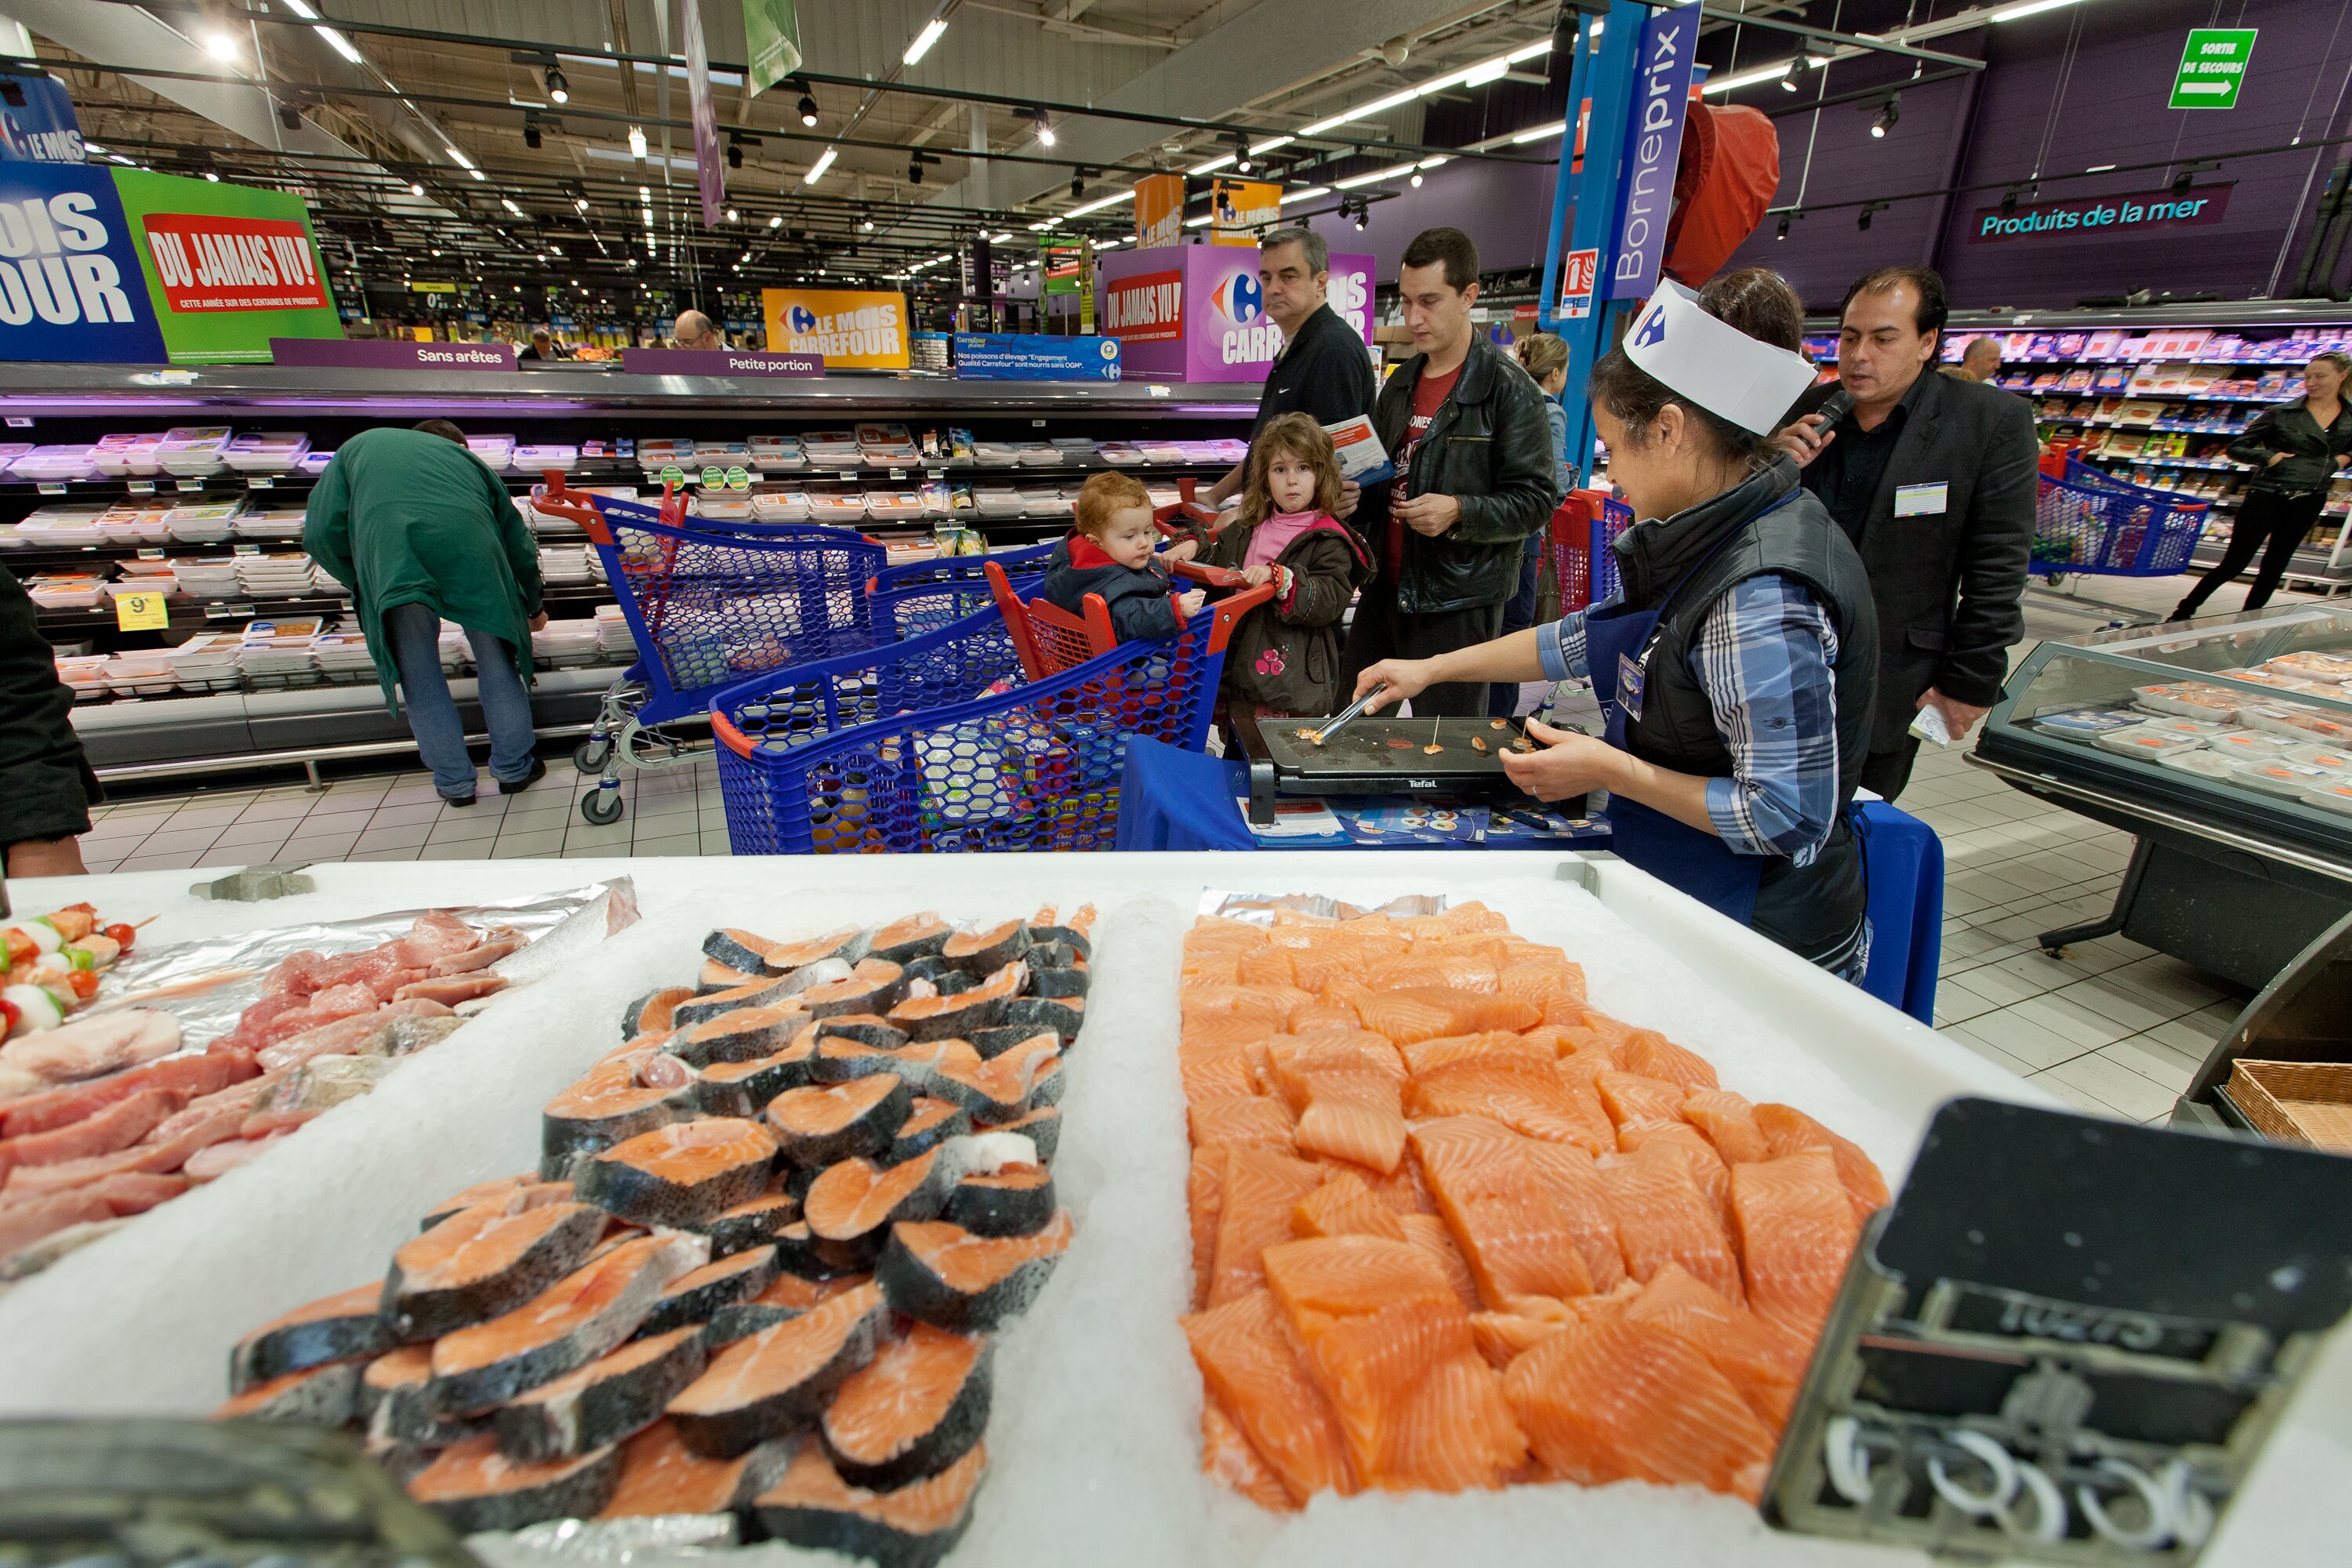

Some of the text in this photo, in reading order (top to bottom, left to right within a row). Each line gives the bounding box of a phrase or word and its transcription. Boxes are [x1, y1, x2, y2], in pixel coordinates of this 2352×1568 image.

[2200, 42, 2238, 55] SORTIE
[2182, 62, 2244, 74] DE SECOURS
[27, 133, 46, 159] LE
[1236, 210, 1245, 223] LE
[1980, 198, 2208, 236] Produits de la mer
[1147, 224, 1156, 244] LE
[148, 231, 194, 287] DU
[191, 233, 278, 287] JAMAIS
[1326, 271, 1367, 311] OIS
[180, 299, 202, 308] CETTE
[202, 297, 226, 307] ANNÉE
[1108, 292, 1119, 328] DU
[1120, 285, 1156, 328] JAMAIS
[815, 304, 898, 335] LE MOIS
[789, 328, 899, 357] CARREFOUR
[417, 350, 503, 364] Sans arêtes
[729, 358, 813, 372] Petite portion
[1408, 415, 1433, 429] ONES
